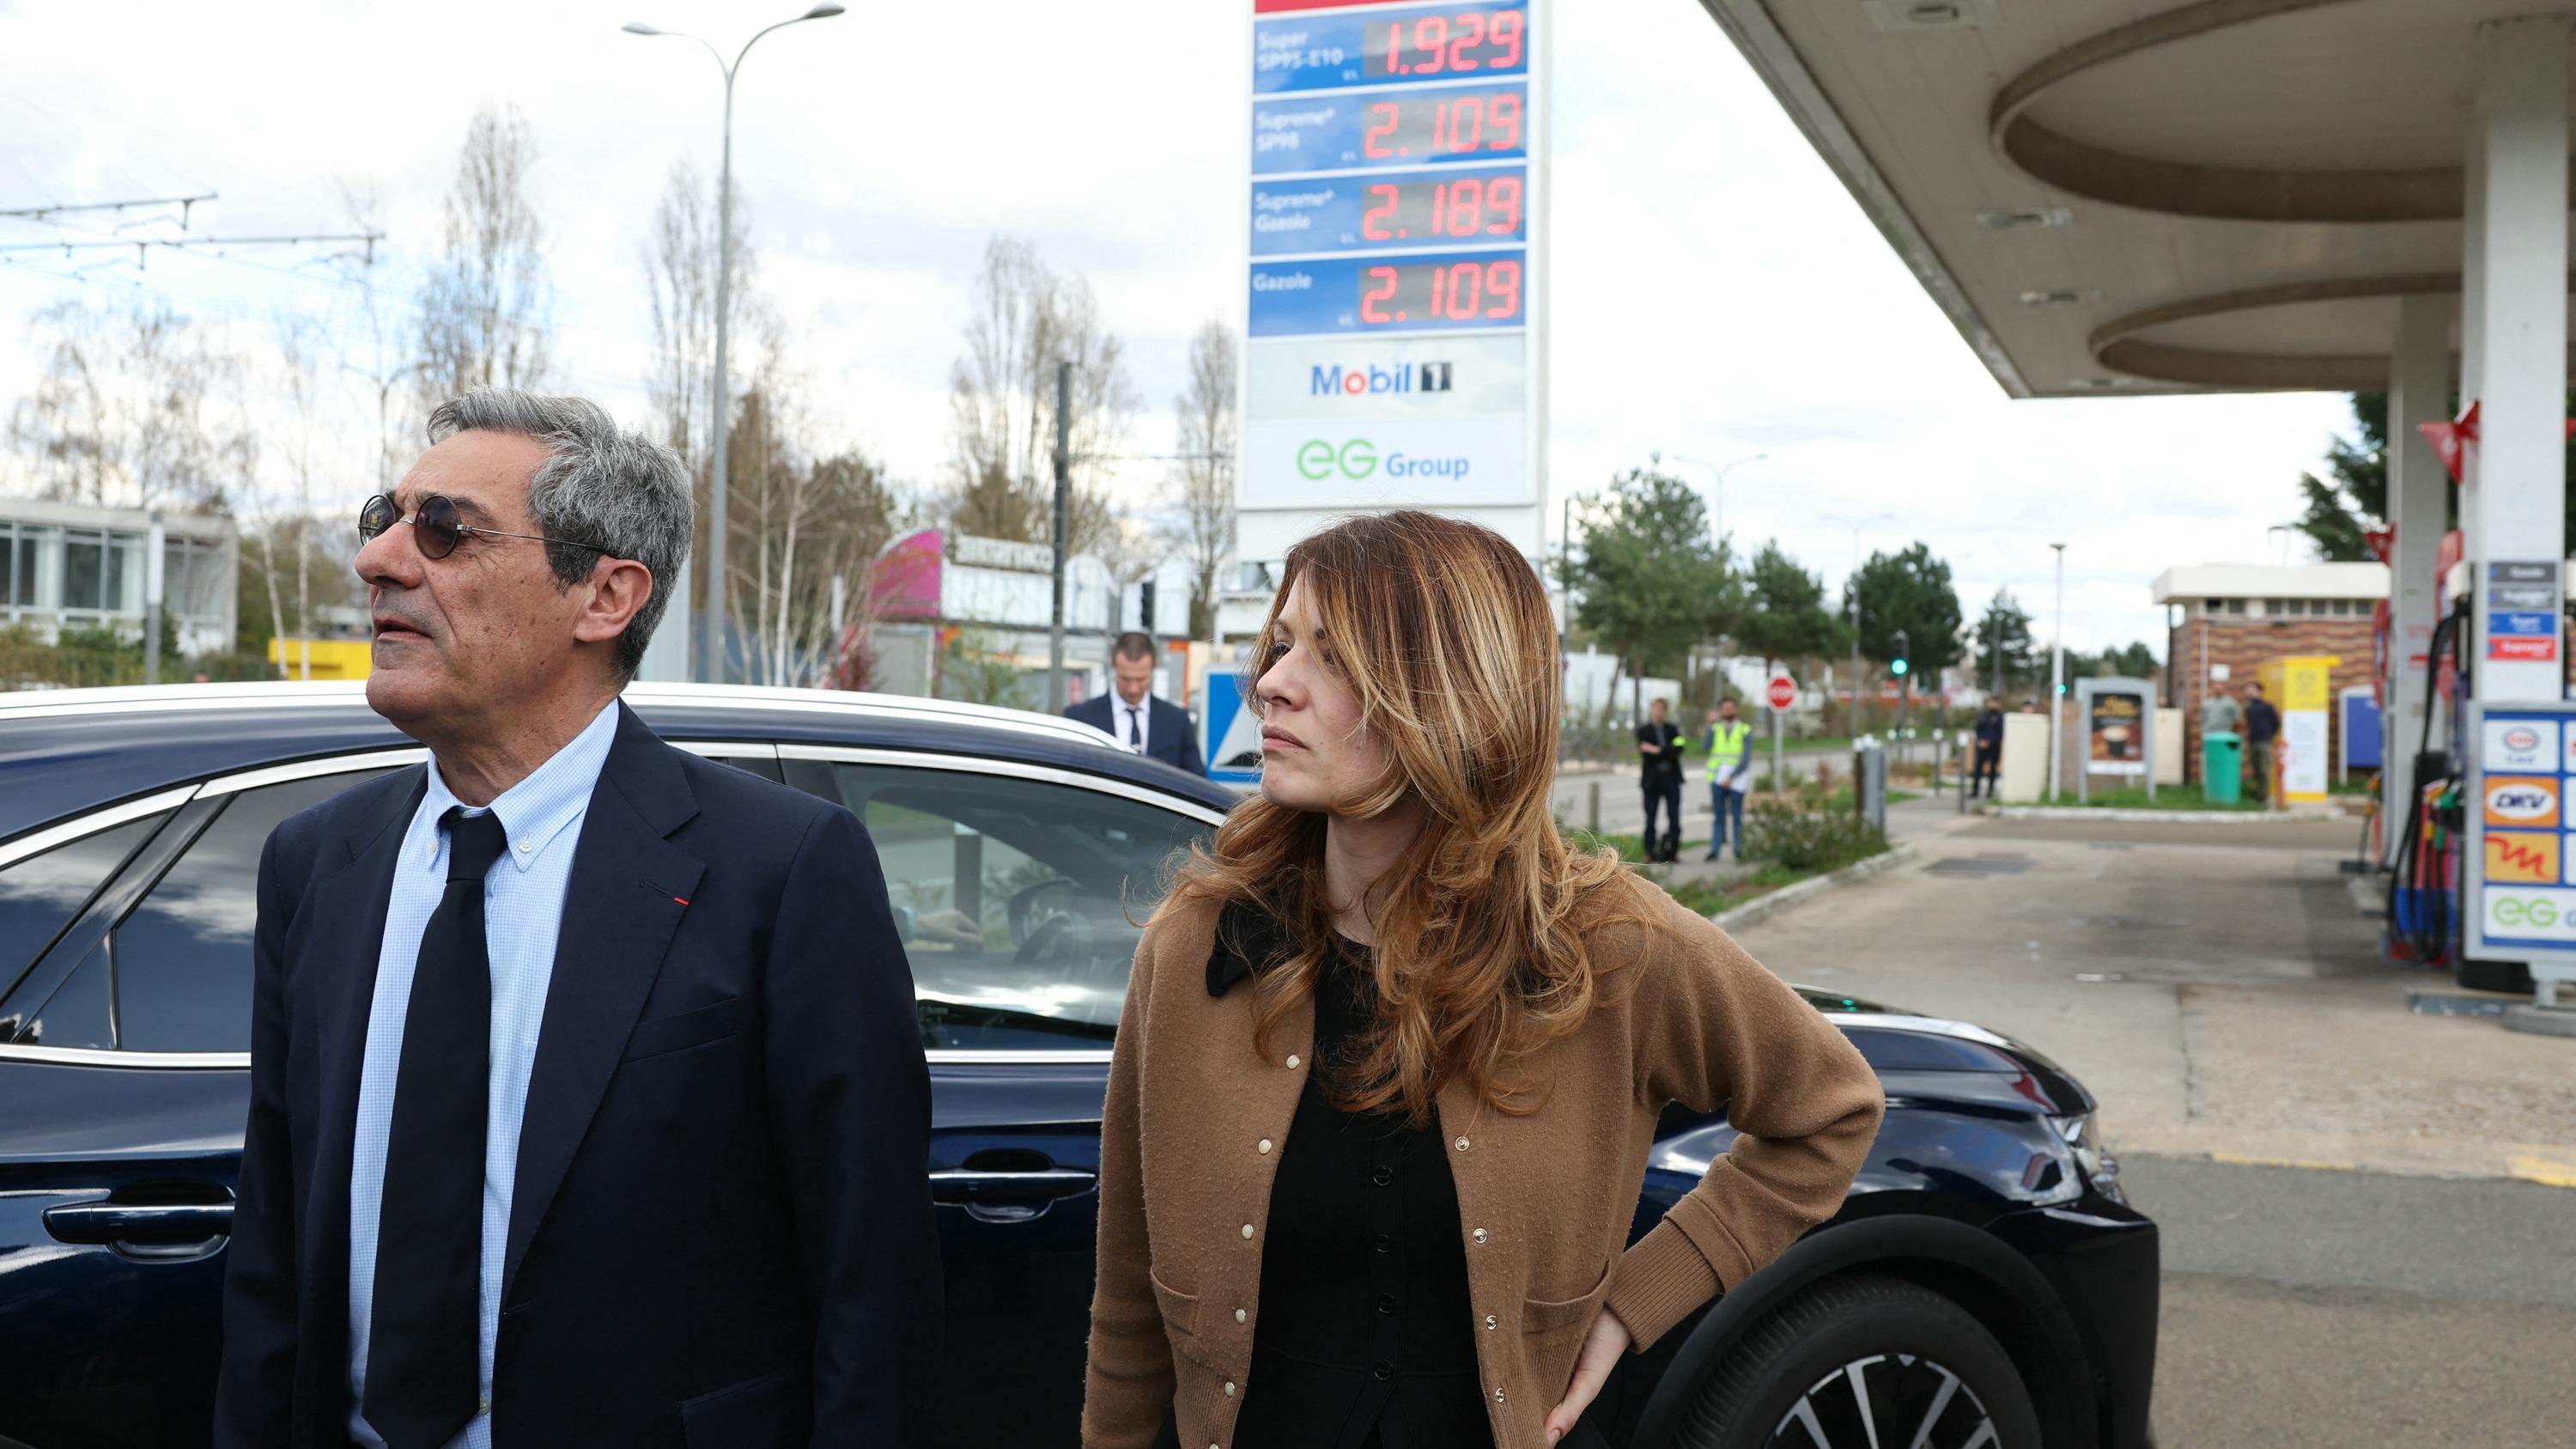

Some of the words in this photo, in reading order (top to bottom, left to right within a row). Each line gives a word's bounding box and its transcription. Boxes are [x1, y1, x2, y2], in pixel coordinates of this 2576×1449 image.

[1257, 32, 1308, 51] Super
[1387, 10, 1524, 75] 1.929
[1256, 47, 1344, 71] SP95-E10
[1364, 94, 1521, 158] 2.109
[1255, 131, 1300, 151] SP98
[1255, 212, 1311, 232] Gazole
[1362, 177, 1522, 240] 2.189
[1252, 271, 1313, 291] Gazole
[1361, 260, 1521, 324] 2.109
[1311, 363, 1412, 395] Mobil
[1386, 453, 1470, 481] Group
